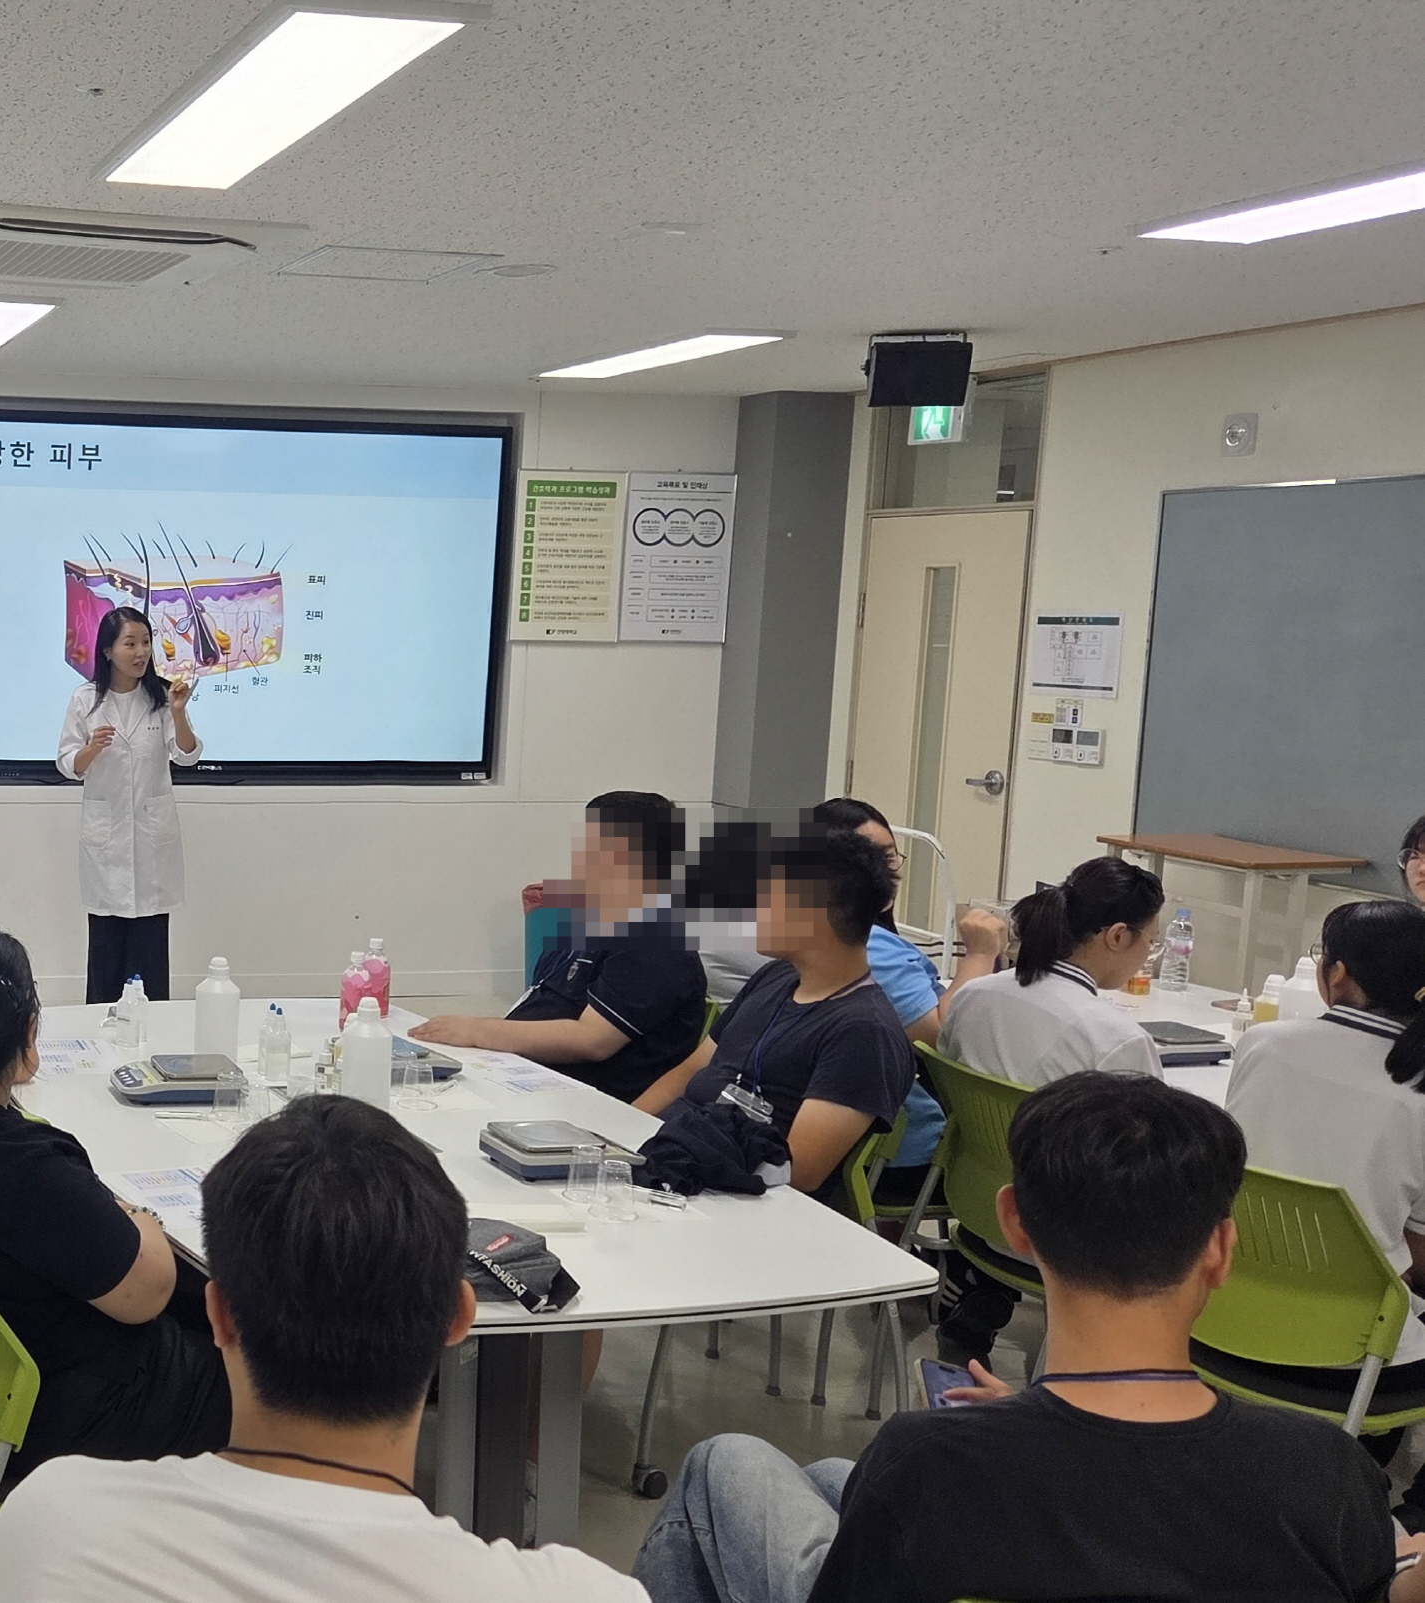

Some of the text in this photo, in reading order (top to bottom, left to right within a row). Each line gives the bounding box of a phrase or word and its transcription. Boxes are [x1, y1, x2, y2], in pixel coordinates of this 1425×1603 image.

[49, 442, 103, 471] 피부
[307, 575, 326, 585] 표피
[305, 610, 324, 620] 진피
[303, 653, 323, 663] 피하
[302, 665, 321, 675] 조직
[251, 676, 269, 686] 혈관
[213, 684, 240, 694] 피지선
